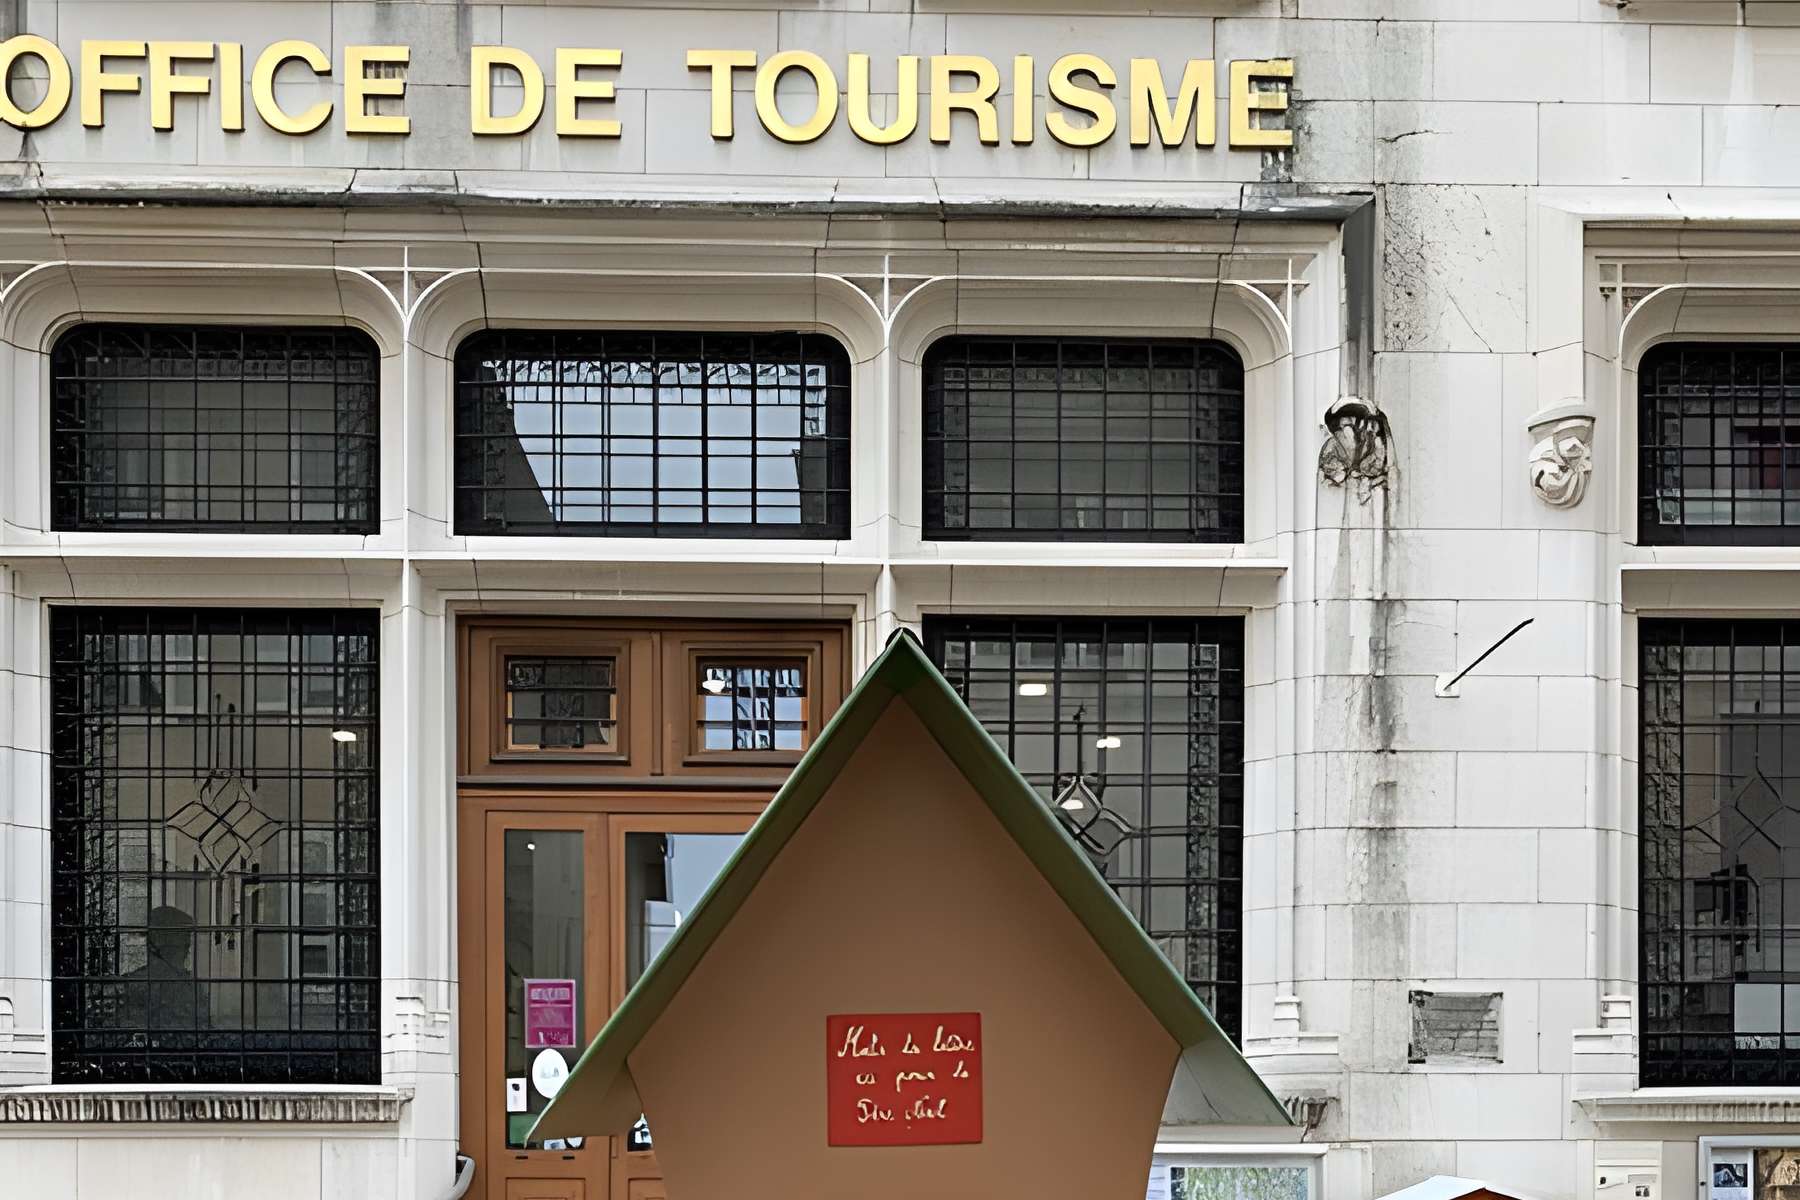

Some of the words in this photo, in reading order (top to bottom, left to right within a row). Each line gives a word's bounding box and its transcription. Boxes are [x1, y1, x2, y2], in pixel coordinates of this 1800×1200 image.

[0, 34, 411, 135] OFFICE
[471, 45, 622, 138] DE
[687, 50, 1293, 149] TOURISME
